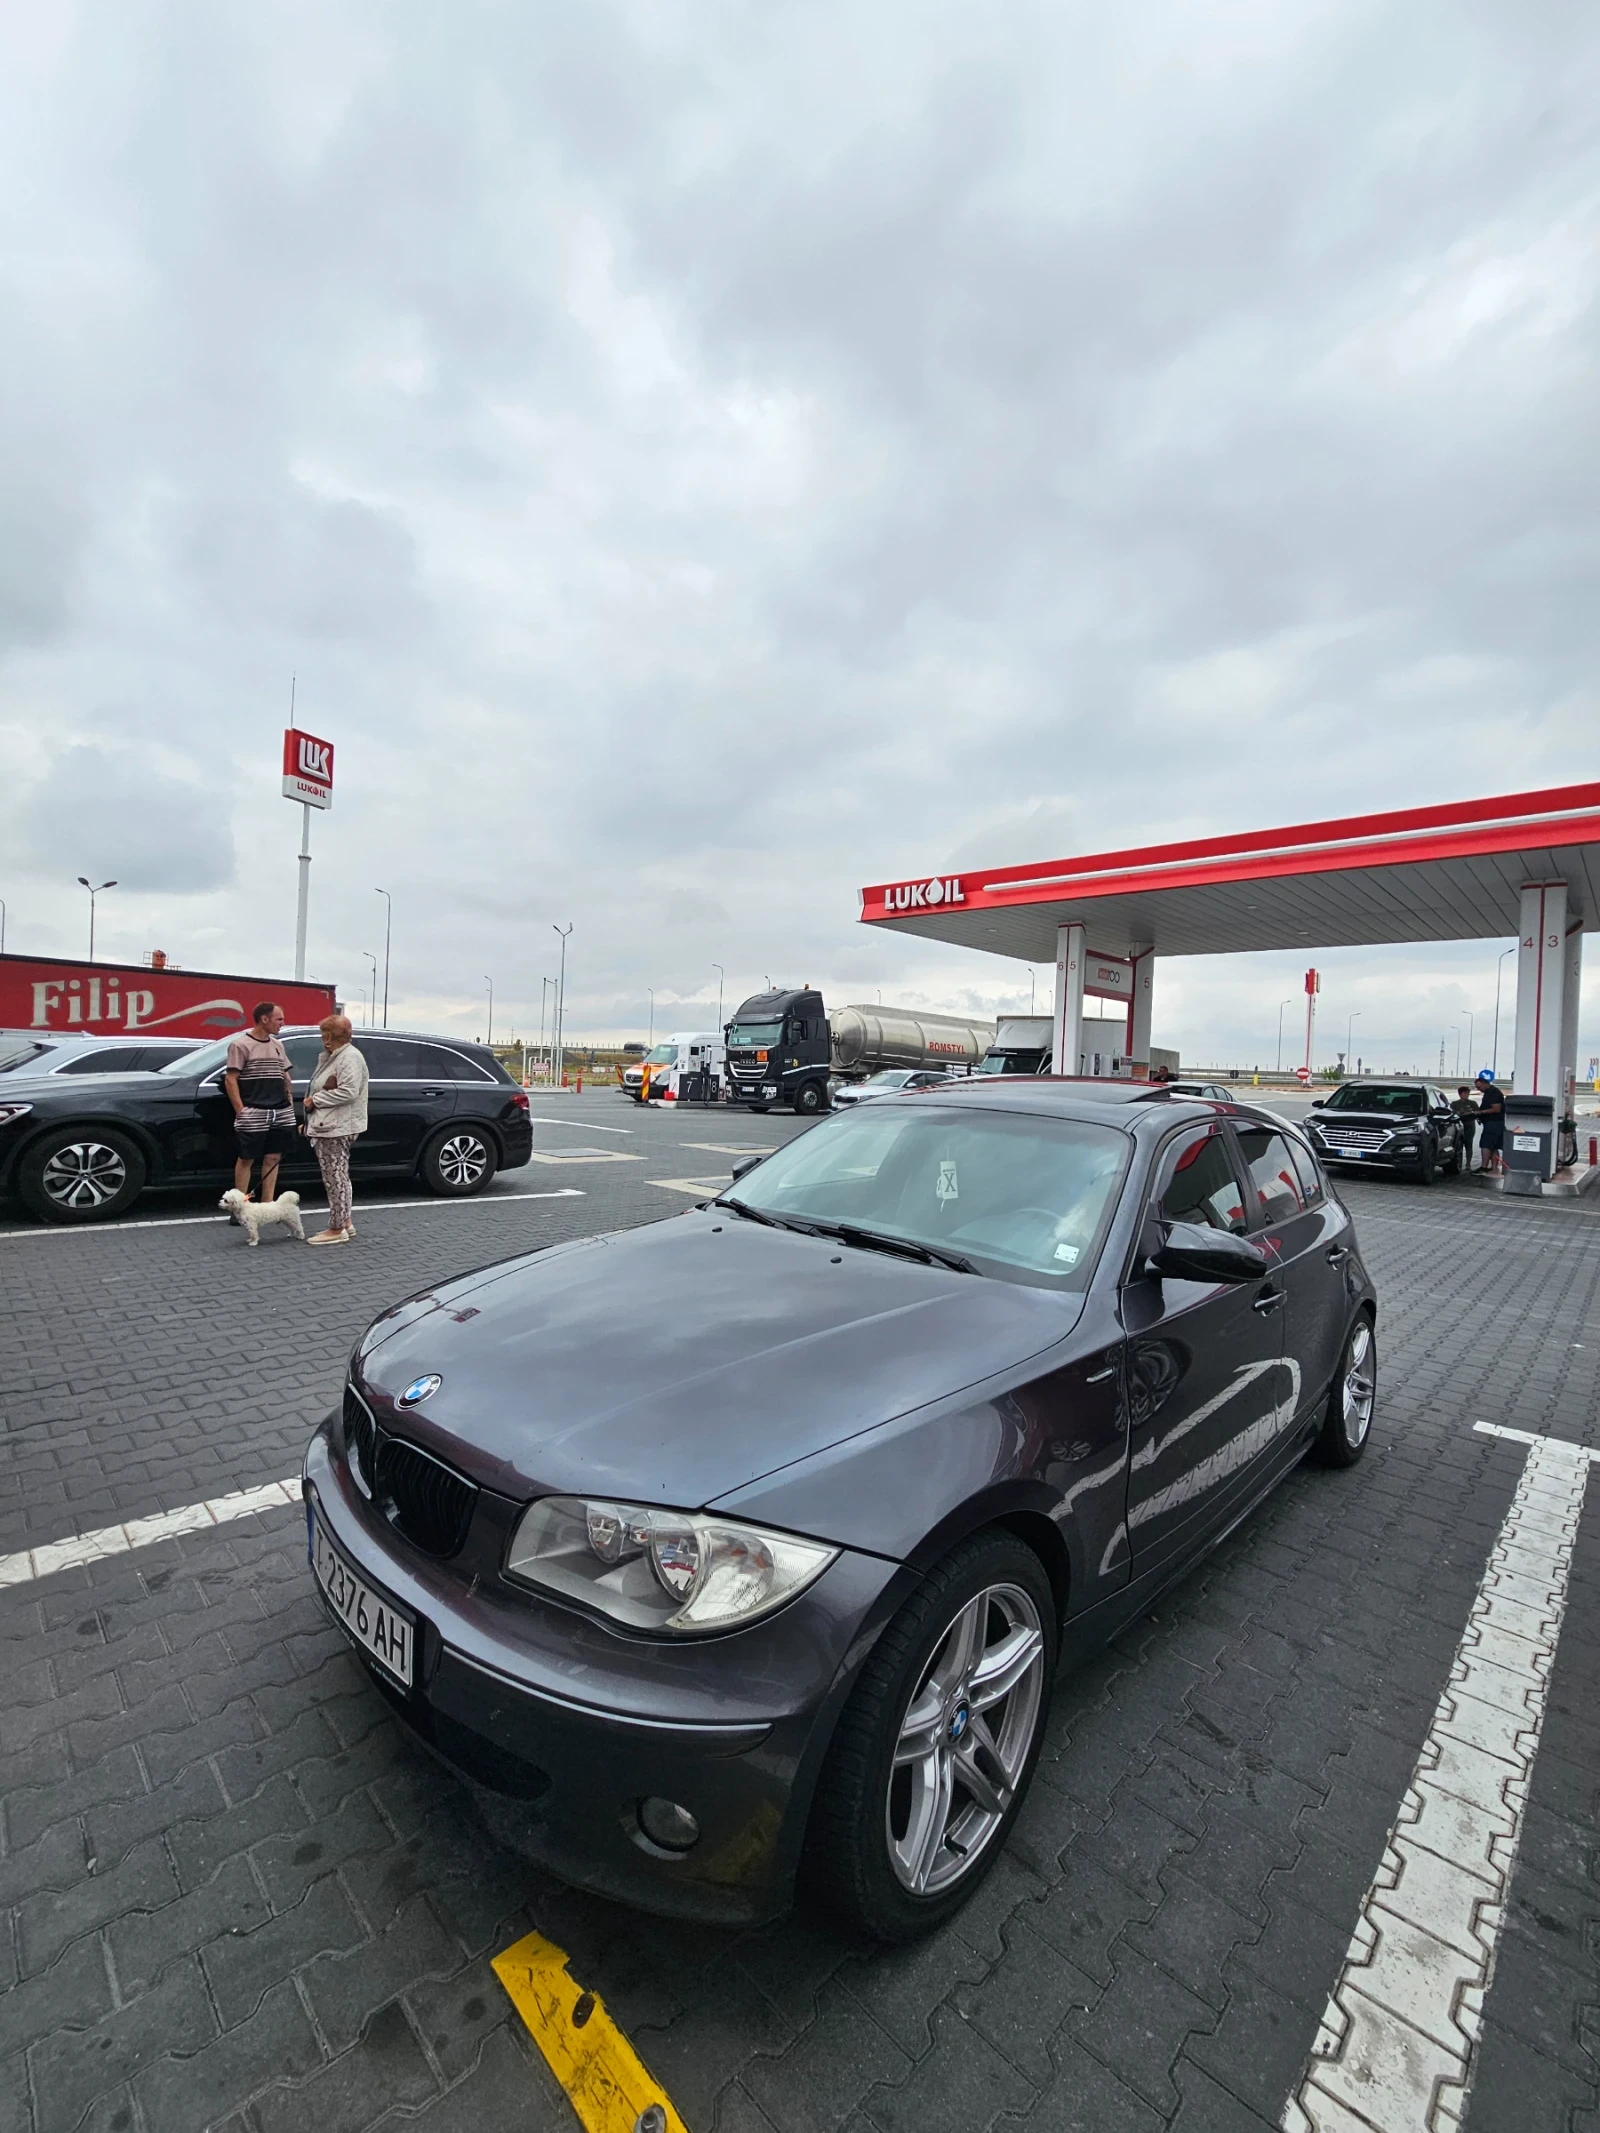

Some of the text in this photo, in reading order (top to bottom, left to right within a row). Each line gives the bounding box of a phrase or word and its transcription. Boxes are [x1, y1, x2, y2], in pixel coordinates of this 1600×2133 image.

[297, 781, 327, 799] LUKOIL
[884, 876, 965, 910] LUKOIL
[1523, 936, 1534, 949] 4
[1547, 935, 1559, 948] 3
[1058, 961, 1065, 970] 6
[1069, 961, 1077, 970] 5
[1143, 977, 1150, 989] 5
[30, 977, 155, 1030] Filip
[929, 1041, 966, 1055] ROMSTYL
[686, 1081, 693, 1093] 7
[711, 1081, 718, 1093] 8
[943, 1172, 957, 1192] X
[327, 1551, 370, 1636] 2376
[373, 1606, 406, 1672] AH
